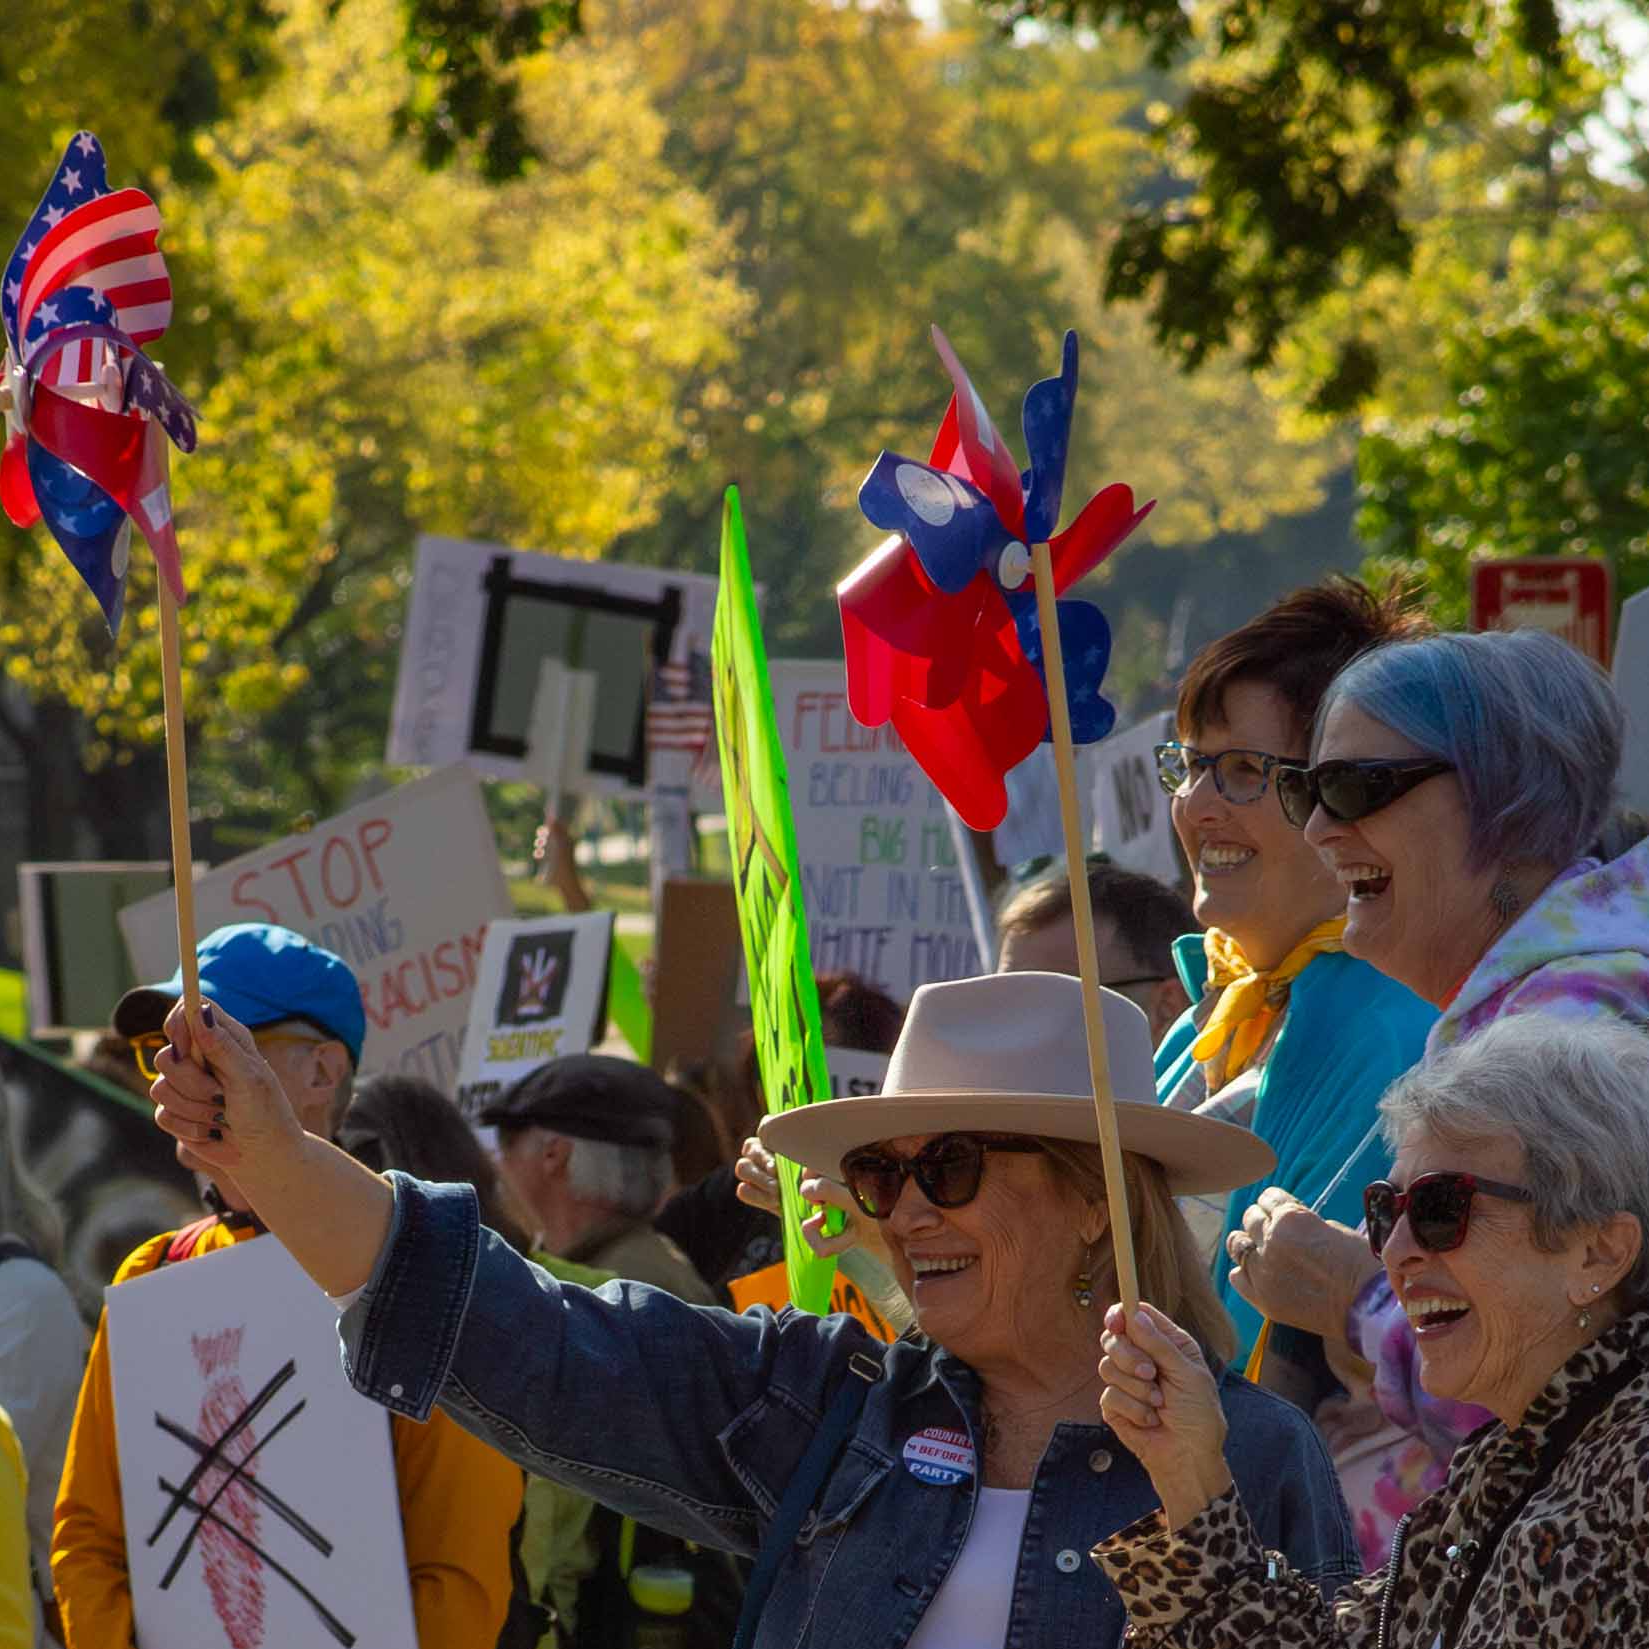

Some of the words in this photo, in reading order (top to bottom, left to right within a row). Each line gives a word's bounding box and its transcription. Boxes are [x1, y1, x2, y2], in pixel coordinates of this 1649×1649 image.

[231, 818, 394, 924] STOP
[917, 1443, 967, 1464] BEFORE
[909, 1462, 963, 1484] PARTY
